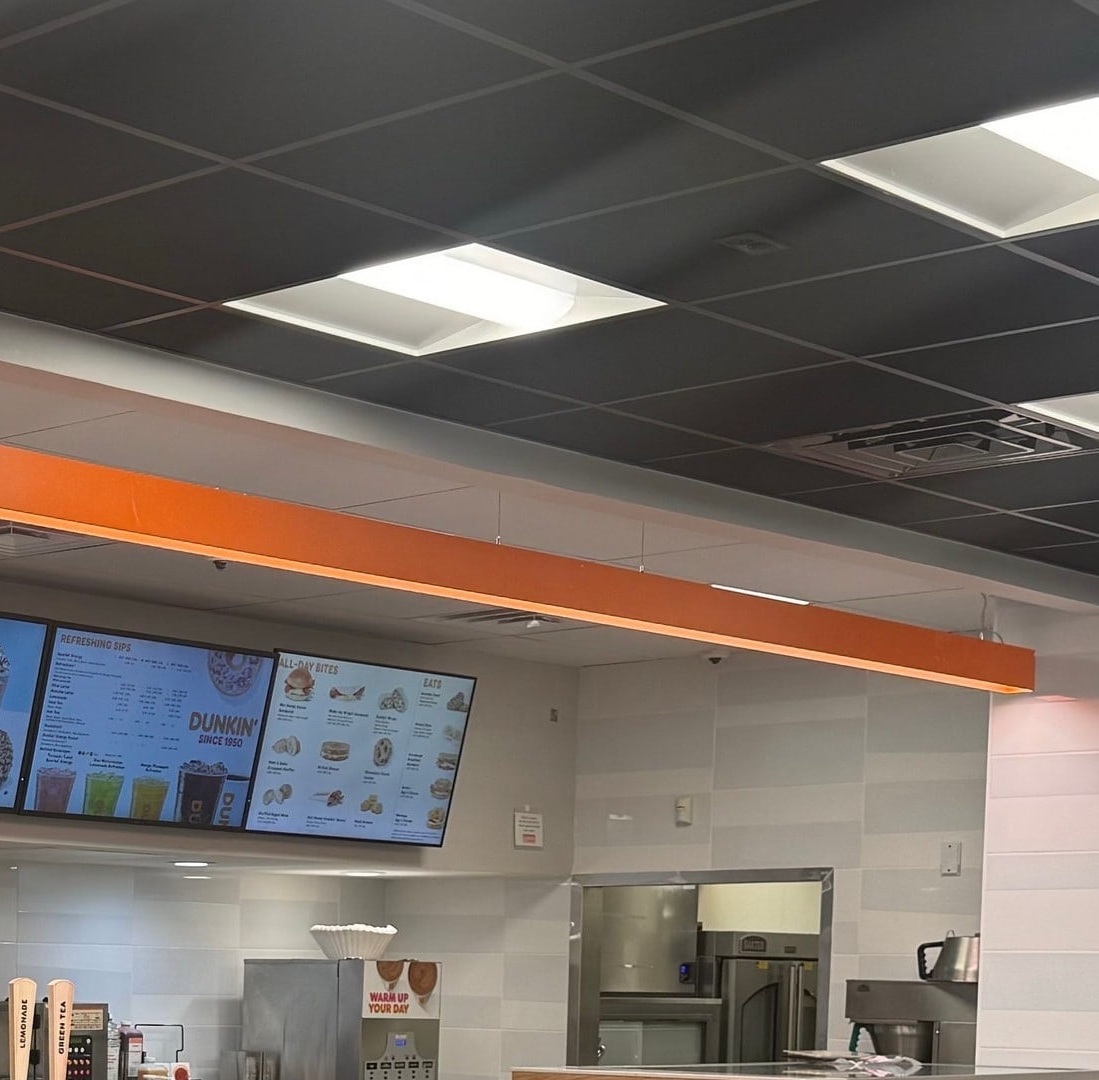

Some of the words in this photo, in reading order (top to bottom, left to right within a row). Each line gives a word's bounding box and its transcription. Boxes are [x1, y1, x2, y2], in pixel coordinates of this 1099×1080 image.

[61, 634, 111, 649] REFRESHING
[113, 641, 131, 652] SIPS
[315, 662, 339, 675] BITES
[423, 678, 442, 689] EATS
[188, 711, 258, 737] DUNKIN'
[198, 734, 222, 745] SINCE
[224, 737, 243, 748] 1950
[370, 992, 396, 1002] WARM
[398, 993, 409, 1003] UP
[59, 1001, 67, 1019] TEA
[368, 1003, 391, 1013] YOUR
[393, 1004, 409, 1014] DAY
[19, 999, 28, 1049] LEMONADE
